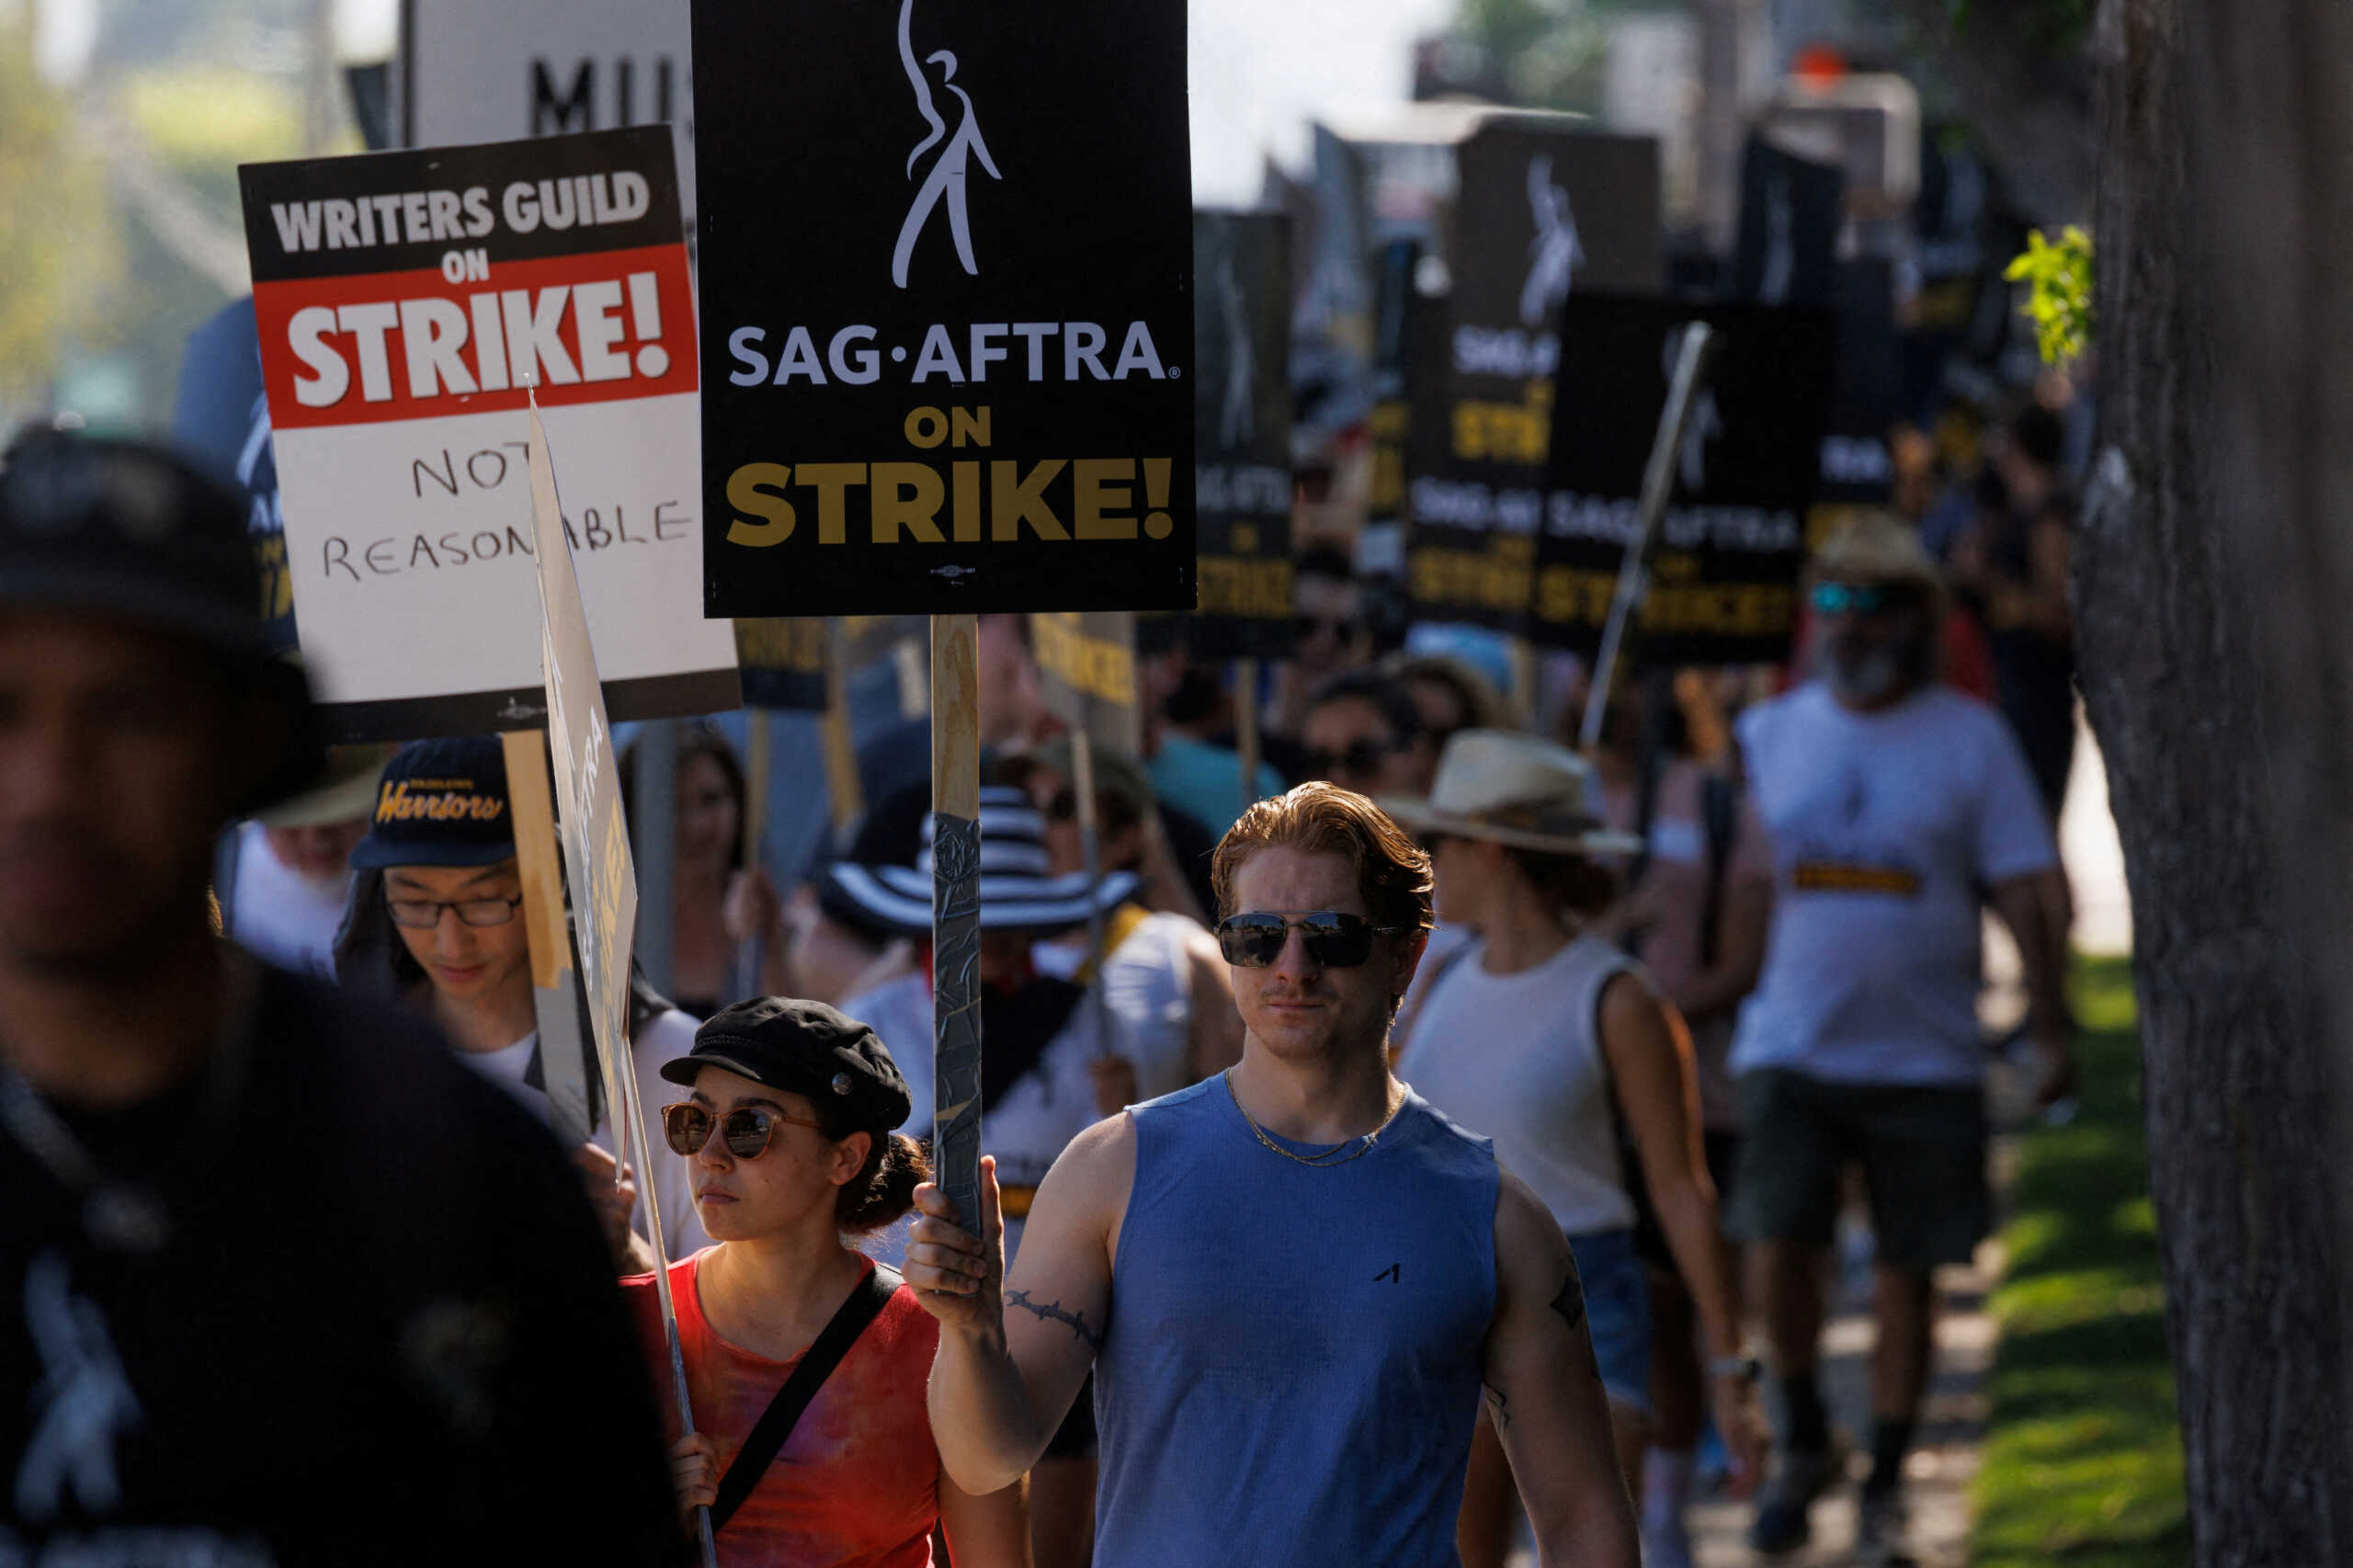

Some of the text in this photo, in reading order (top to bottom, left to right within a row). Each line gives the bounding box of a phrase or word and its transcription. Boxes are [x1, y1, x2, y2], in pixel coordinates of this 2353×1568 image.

[271, 171, 650, 253] WRITERS GUILD
[441, 248, 490, 284] ON
[288, 271, 670, 408] STRIKE!
[904, 405, 991, 449] ON
[726, 457, 1174, 547] STRIKE!
[376, 780, 503, 824] Warriors
